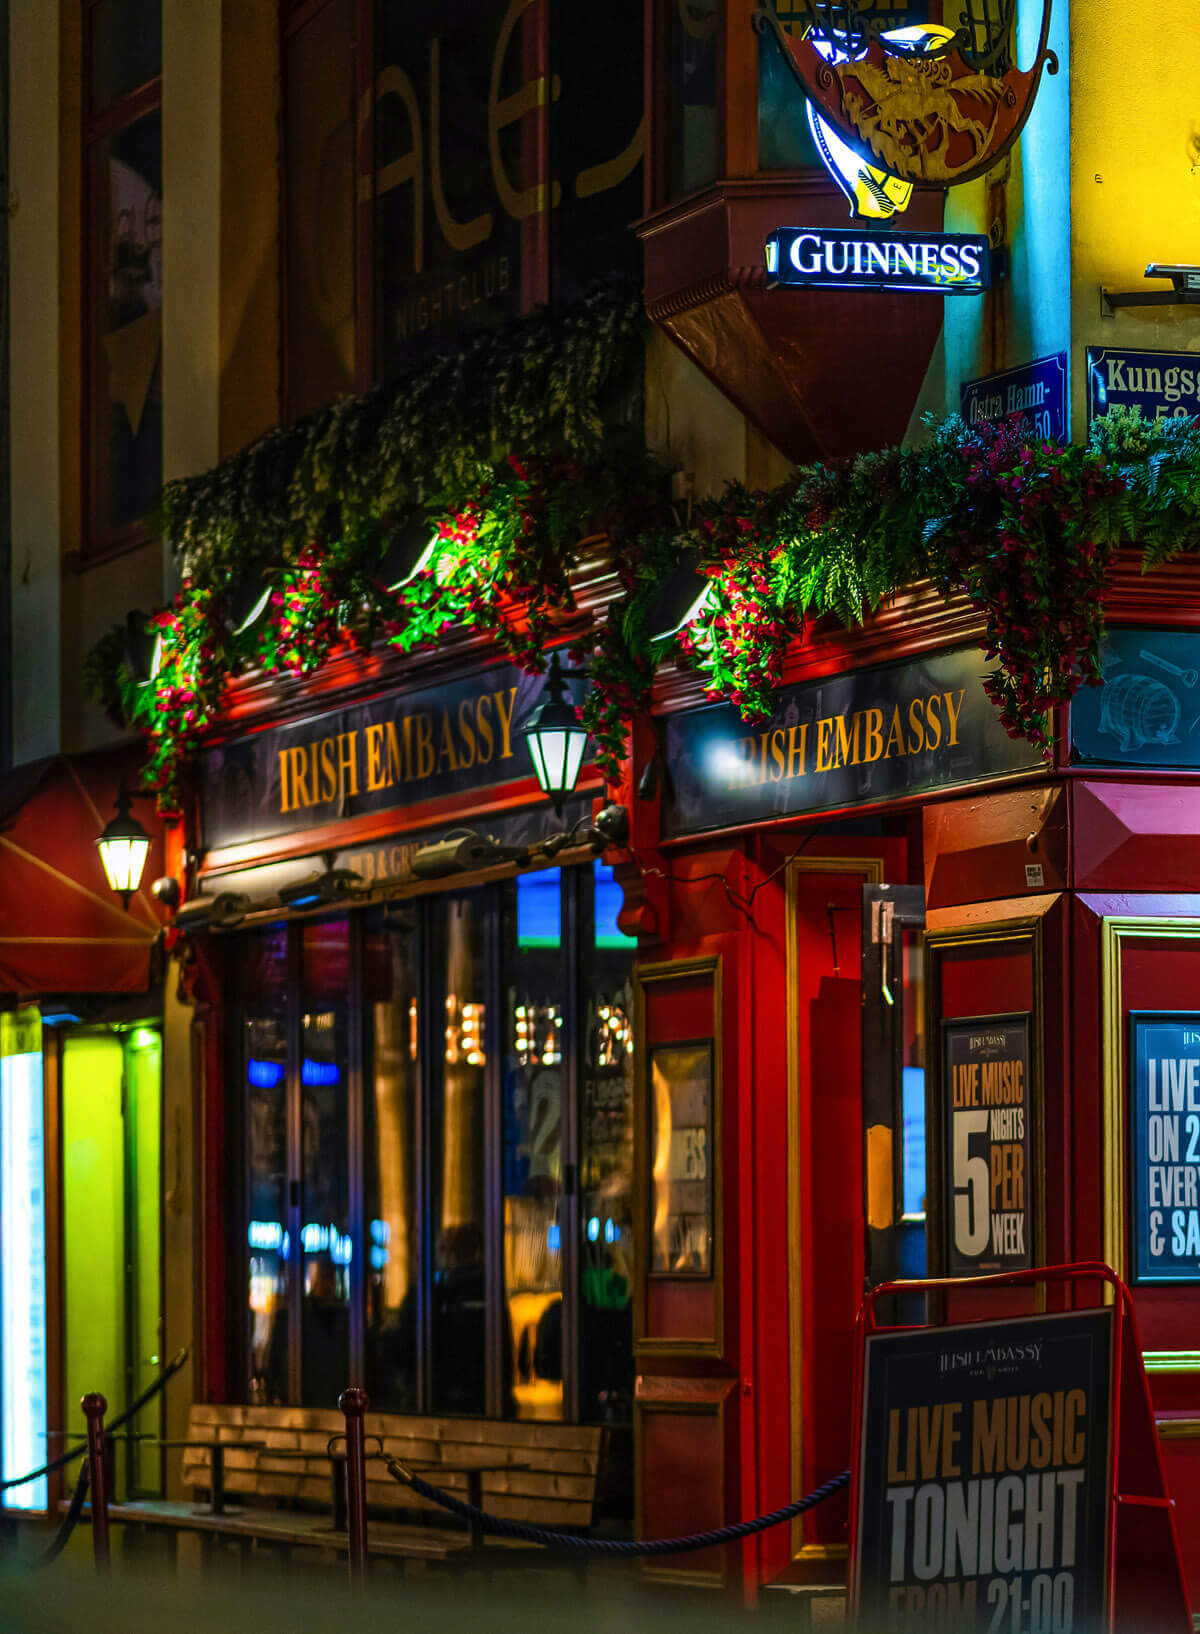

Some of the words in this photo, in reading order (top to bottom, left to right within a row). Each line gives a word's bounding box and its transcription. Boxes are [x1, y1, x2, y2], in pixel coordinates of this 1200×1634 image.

[789, 234, 980, 277] GUINNESS
[969, 388, 1004, 425] Östra
[1007, 381, 1051, 413] Hamn-
[278, 730, 359, 813] IRISH
[366, 687, 518, 792] EMBASSY
[814, 689, 966, 773] EMBASSY
[953, 1063, 979, 1107] LIVE
[982, 1060, 1024, 1106] MUSIC
[1149, 1059, 1200, 1112] LIVE
[990, 1108, 1025, 1141] NIGHTS
[1149, 1115, 1179, 1162] ON
[1185, 1115, 1200, 1162] 2
[953, 1110, 990, 1256] 5
[990, 1144, 1024, 1210] PER
[991, 1213, 1025, 1255] WEEK
[1150, 1210, 1165, 1256] &
[888, 1402, 963, 1483] LIVE
[971, 1388, 1087, 1475] MUSIC
[886, 1468, 1085, 1582] TONIGHT
[987, 1572, 1074, 1634] 21:00
